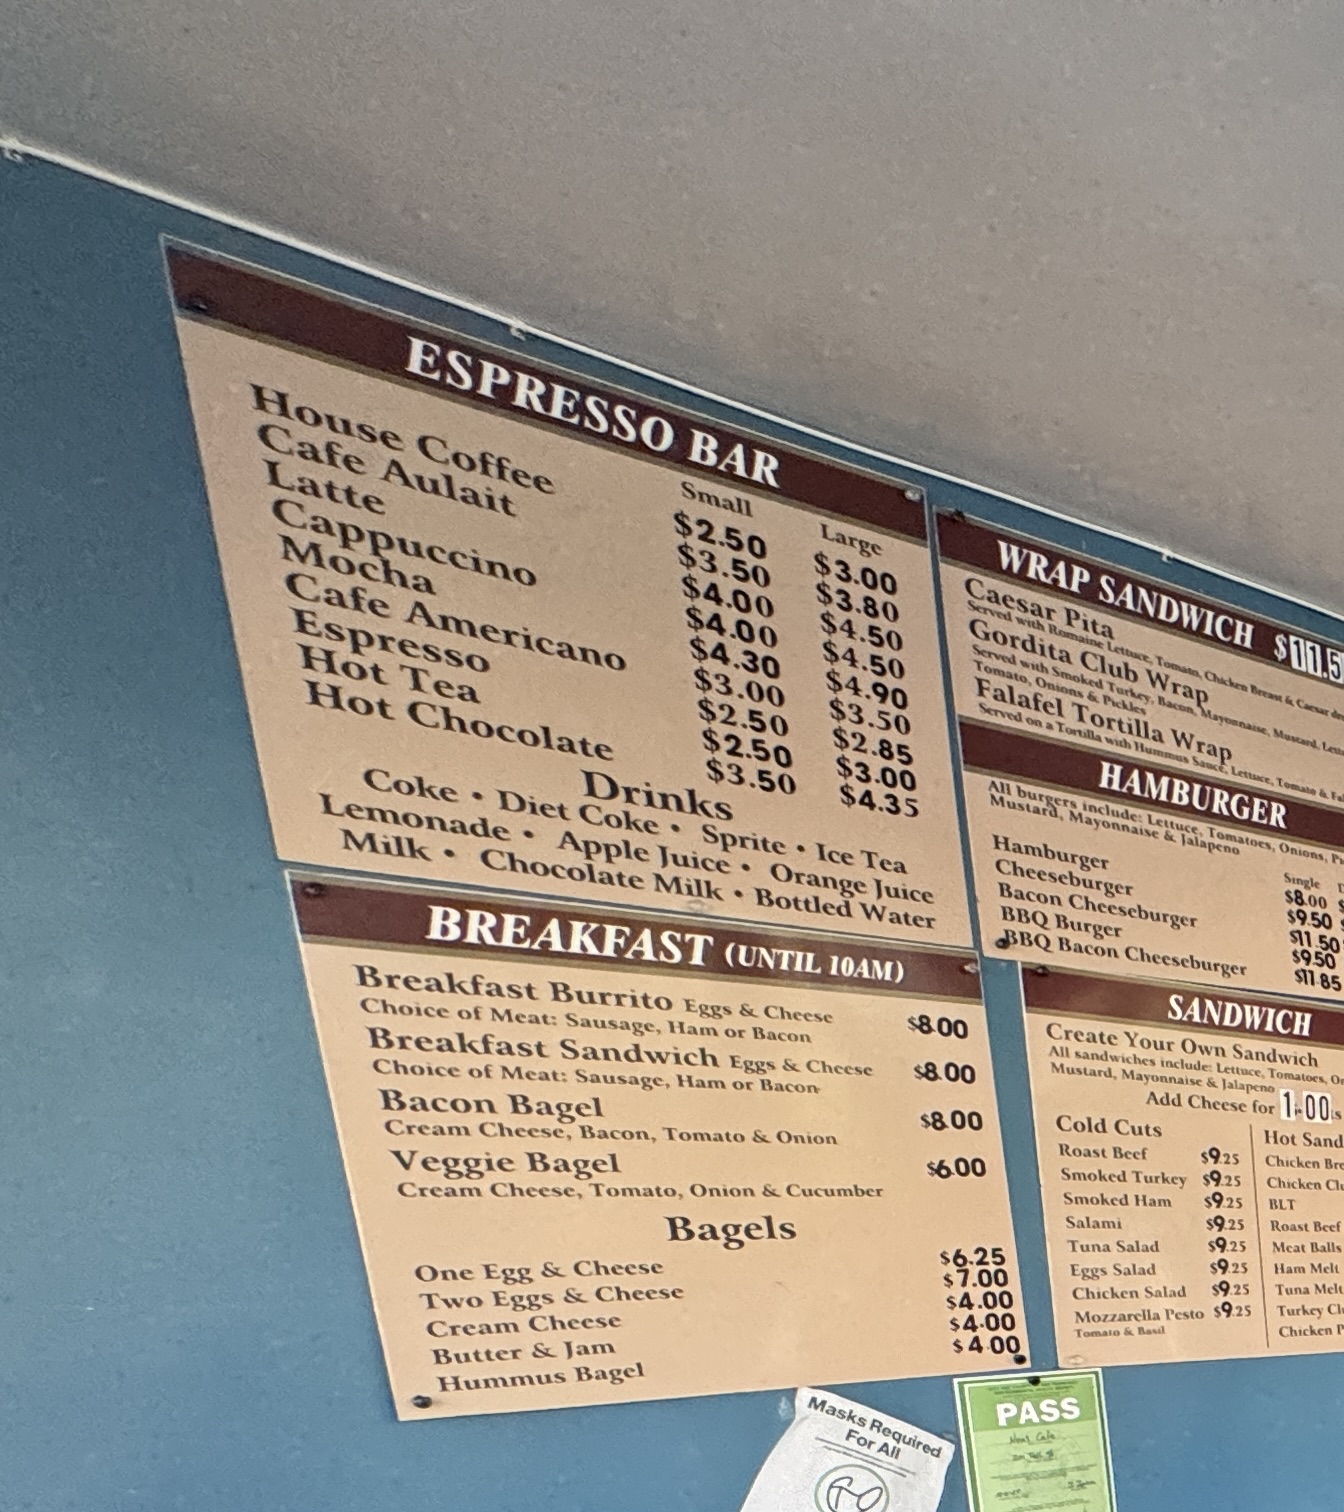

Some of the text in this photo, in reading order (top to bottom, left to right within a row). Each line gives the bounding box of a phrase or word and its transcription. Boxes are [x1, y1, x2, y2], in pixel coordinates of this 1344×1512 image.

[405, 336, 779, 488] ESPRESSO BAR
[248, 382, 899, 597] House Coffee $2.50 $3.00
[680, 480, 883, 559] Small Large
[256, 423, 900, 624] Cafe Aulait $3.50 $3.80
[261, 458, 904, 652] Latte $4.00 $4.50
[271, 498, 906, 680] Cappuccino $4.00 $4.50
[964, 577, 1116, 641] Caesar Pita
[997, 540, 1091, 593] WRAP
[1098, 574, 1254, 649] SANDWICH
[277, 533, 909, 711] Mocha $4.30 $4.90
[284, 572, 912, 736] Cafe Americano $3.00 $3.50
[288, 606, 914, 767] Espresso $2.50 $2.85
[968, 618, 1209, 709] Gordita Club Wrap
[295, 642, 917, 792] Hot Tea $2.50 $3.00
[303, 679, 920, 818] Hot Chocolate $3.50 $4.35
[973, 675, 1233, 766] Falafel Tortilla Wrap
[363, 768, 908, 875] Coke Diet Coke Sprite Ice Tea
[580, 769, 734, 822] Drinks
[1098, 761, 1286, 829] HAMBURGER
[318, 792, 935, 905] Lemonade Apple Juice Orange Juice
[339, 828, 937, 930] Milk Chocolate Milk Bottled Water
[991, 833, 1110, 873] Hamburger
[994, 858, 1134, 899] Cheeseburger
[997, 881, 1198, 930] Bacon Cheeseburger
[1000, 905, 1123, 940] BBQ Burger
[425, 905, 904, 984] BREAKFAST (UNTIL 10AM)
[353, 964, 969, 1040] Breakfast Burrito Eggs & Cheese $8.00
[359, 997, 812, 1043] Choice of Meat: Sausage, Ham or Bacon
[1167, 993, 1312, 1037] SANDWICH
[365, 1026, 976, 1085] Breakfast Sandwich Eggs & Cheese $8.00
[1045, 1022, 1319, 1068] Create Your Own Sandwich
[378, 1088, 984, 1132] Bacon Bagel $8.00
[1055, 1114, 1163, 1138] Cold Cuts
[1264, 1129, 1297, 1147] Hot
[389, 1150, 987, 1181] Veggie Bagel $6.00
[663, 1215, 797, 1251] Bagels
[414, 1246, 1007, 1286] One Egg & Cheese $6.25
[418, 1267, 1009, 1312] Two Eggs & Cheese $7.00
[426, 1289, 1014, 1338] Cream Cheese $4.00
[432, 1312, 1016, 1366] Butter & Jam $4.00
[437, 1334, 1022, 1392] Hummus Bagel $4.00
[807, 1396, 942, 1460] Masks Required
[996, 1397, 1081, 1427] PASS
[845, 1429, 902, 1460] For All
